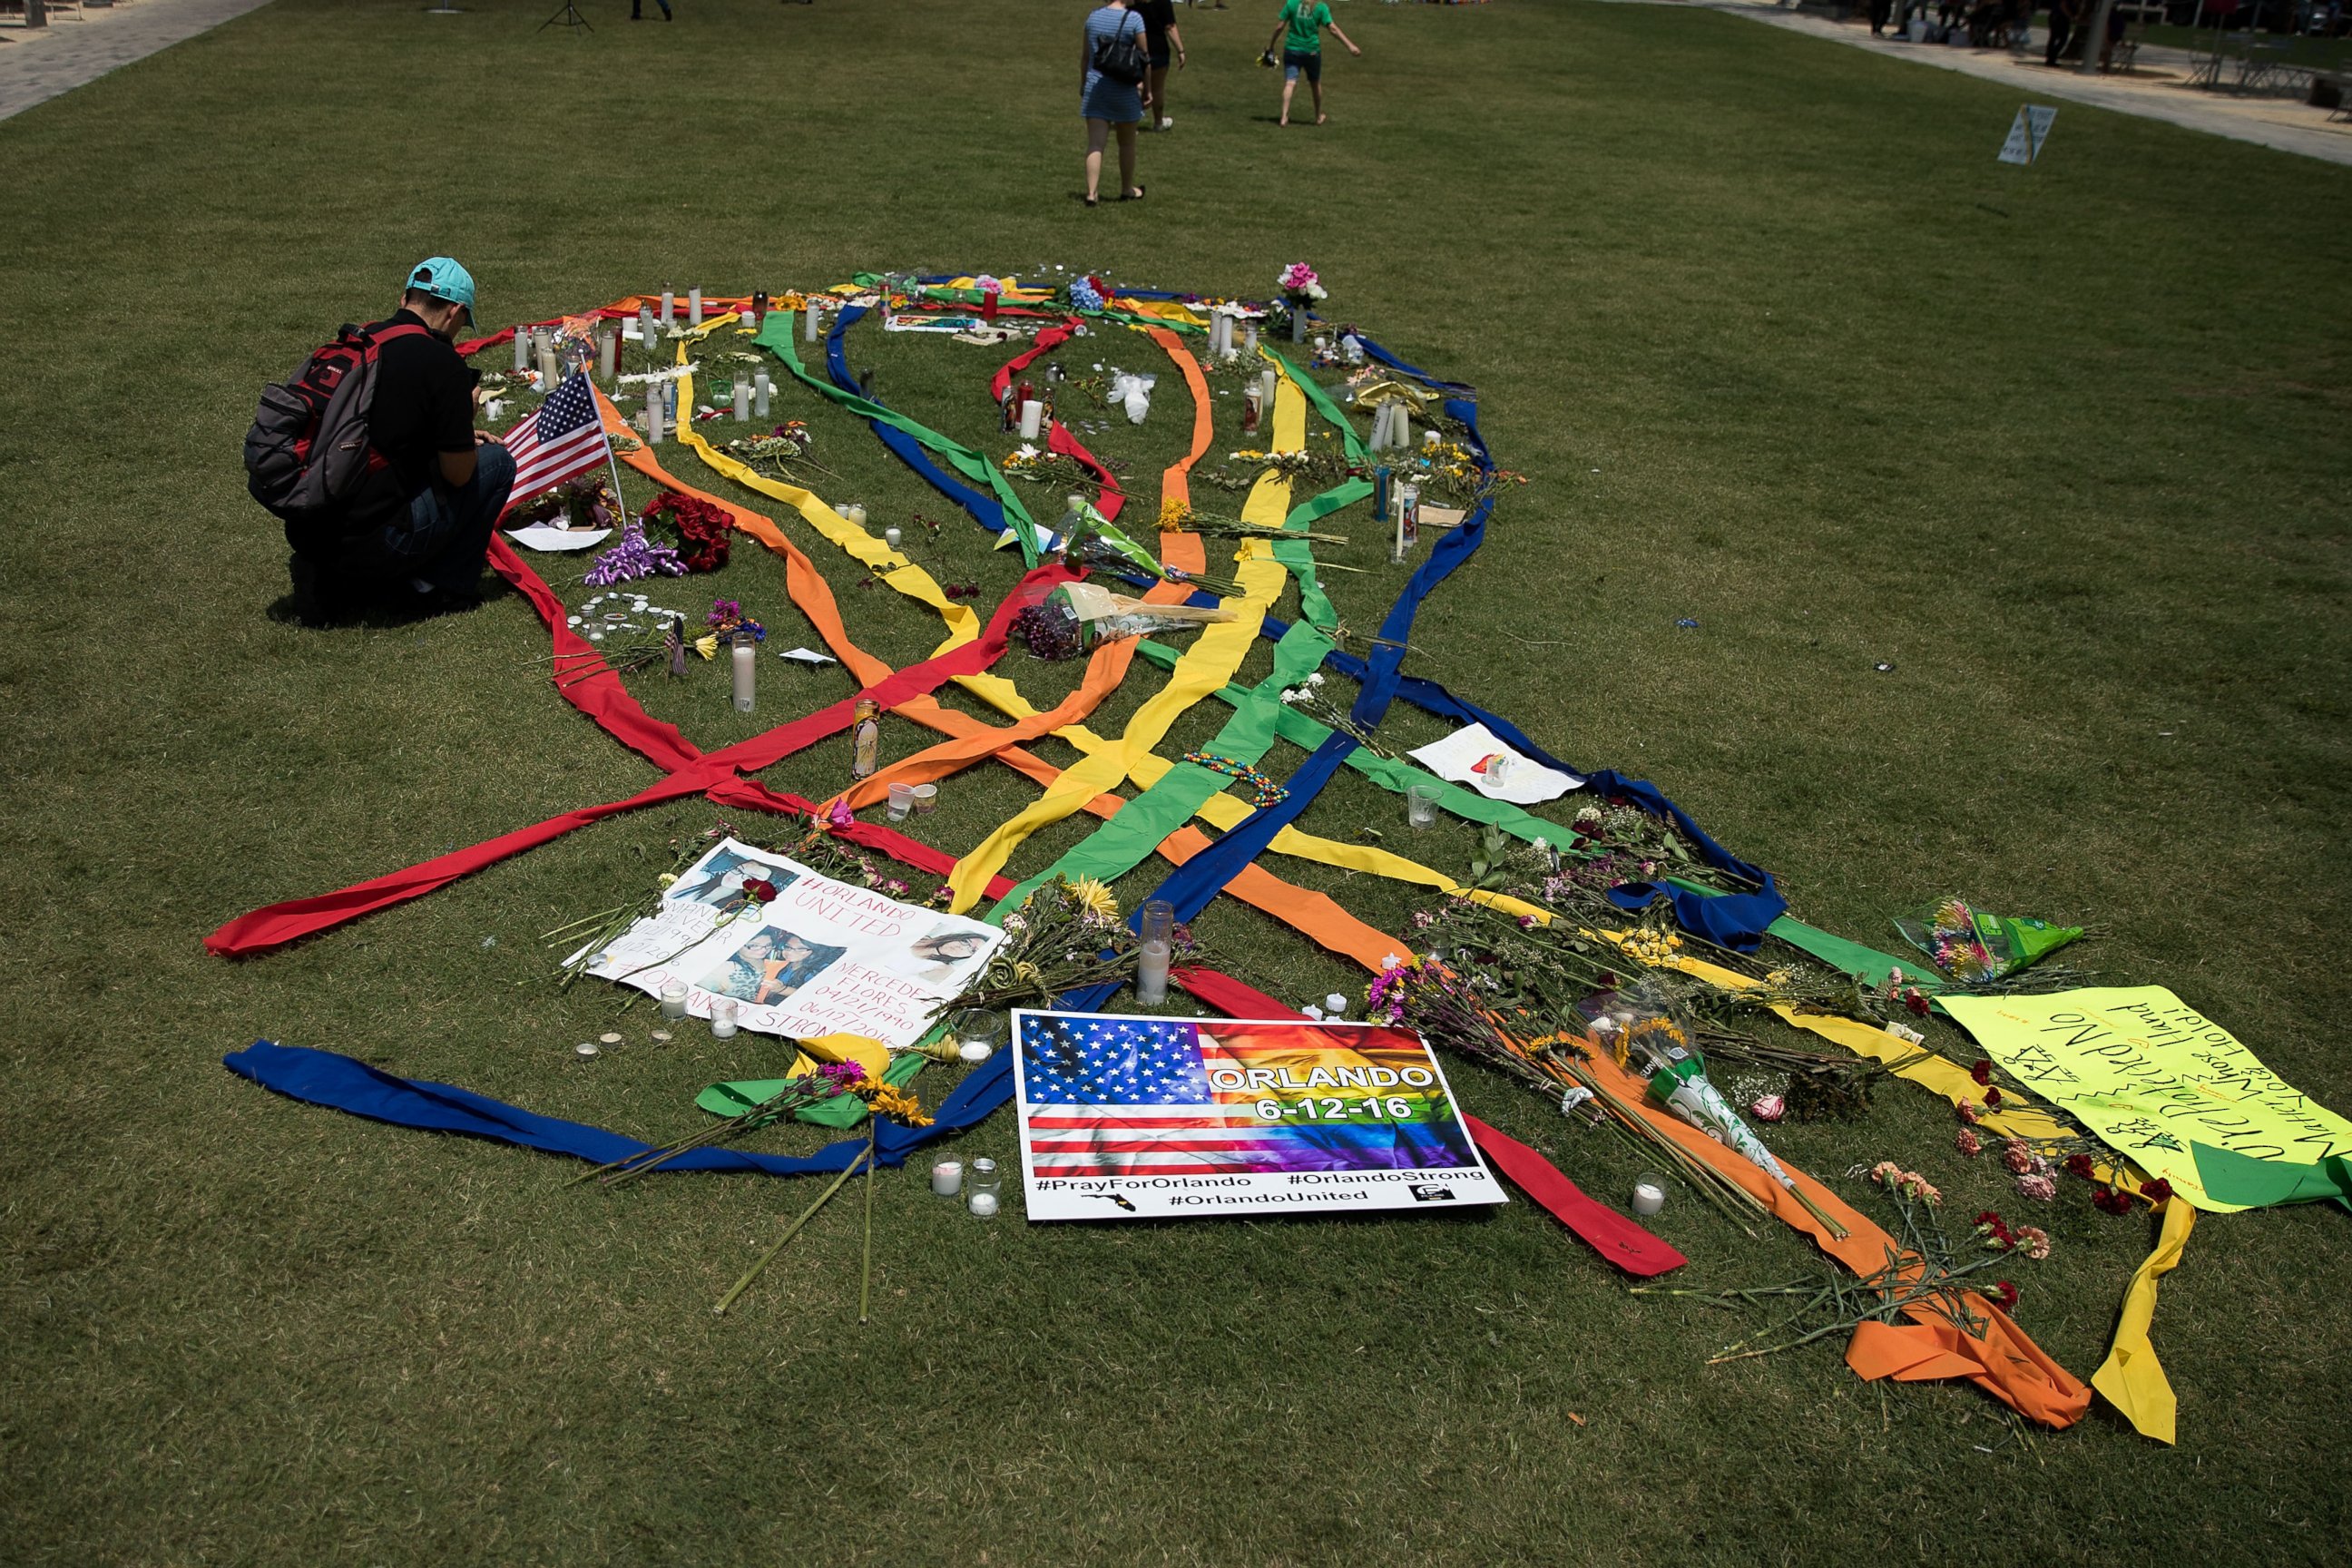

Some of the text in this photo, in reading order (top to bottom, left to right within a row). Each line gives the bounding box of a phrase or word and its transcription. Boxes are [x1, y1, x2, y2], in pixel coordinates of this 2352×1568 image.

[796, 892, 901, 936] UNITED
[801, 877, 916, 921] #ORLANDO
[834, 962, 938, 1008] MERCEDEZ
[837, 976, 910, 1014] FLORES
[756, 1011, 838, 1037] STRON
[815, 985, 915, 1030] 04/21/1990
[2105, 1003, 2194, 1047] Hand
[2040, 1014, 2112, 1047] No
[1210, 1066, 1435, 1090] ORLANDO
[2190, 1050, 2264, 1101] Whose
[1255, 1097, 1413, 1120] 6-12-16
[1035, 1171, 1485, 1192] #PrayForOrlando #OrlandoStrong
[1169, 1191, 1368, 1206] #OrlandoUnited
